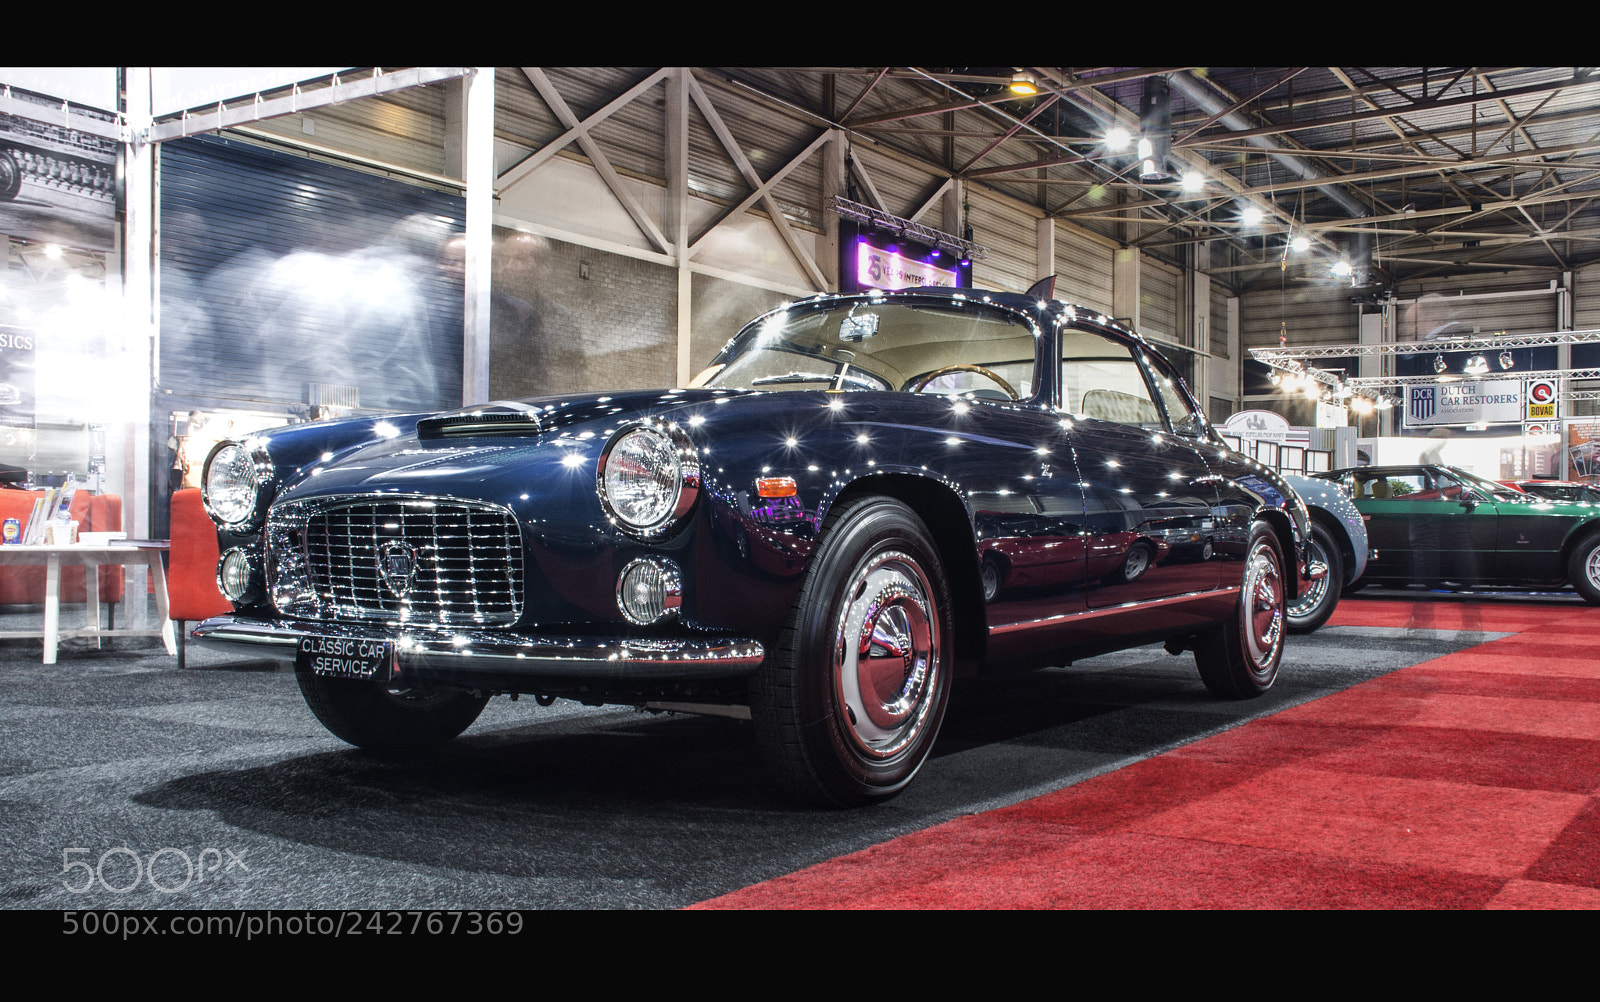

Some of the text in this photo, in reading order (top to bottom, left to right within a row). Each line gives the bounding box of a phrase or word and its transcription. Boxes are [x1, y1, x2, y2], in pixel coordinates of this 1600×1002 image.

[1413, 389, 1433, 399] DCR
[1441, 385, 1476, 395] DUTCH
[1441, 394, 1518, 406] CAR RESTORERS
[1531, 406, 1553, 416] BOVAG
[302, 639, 385, 659] CLASSIC CAR
[316, 657, 369, 674] SERVICE
